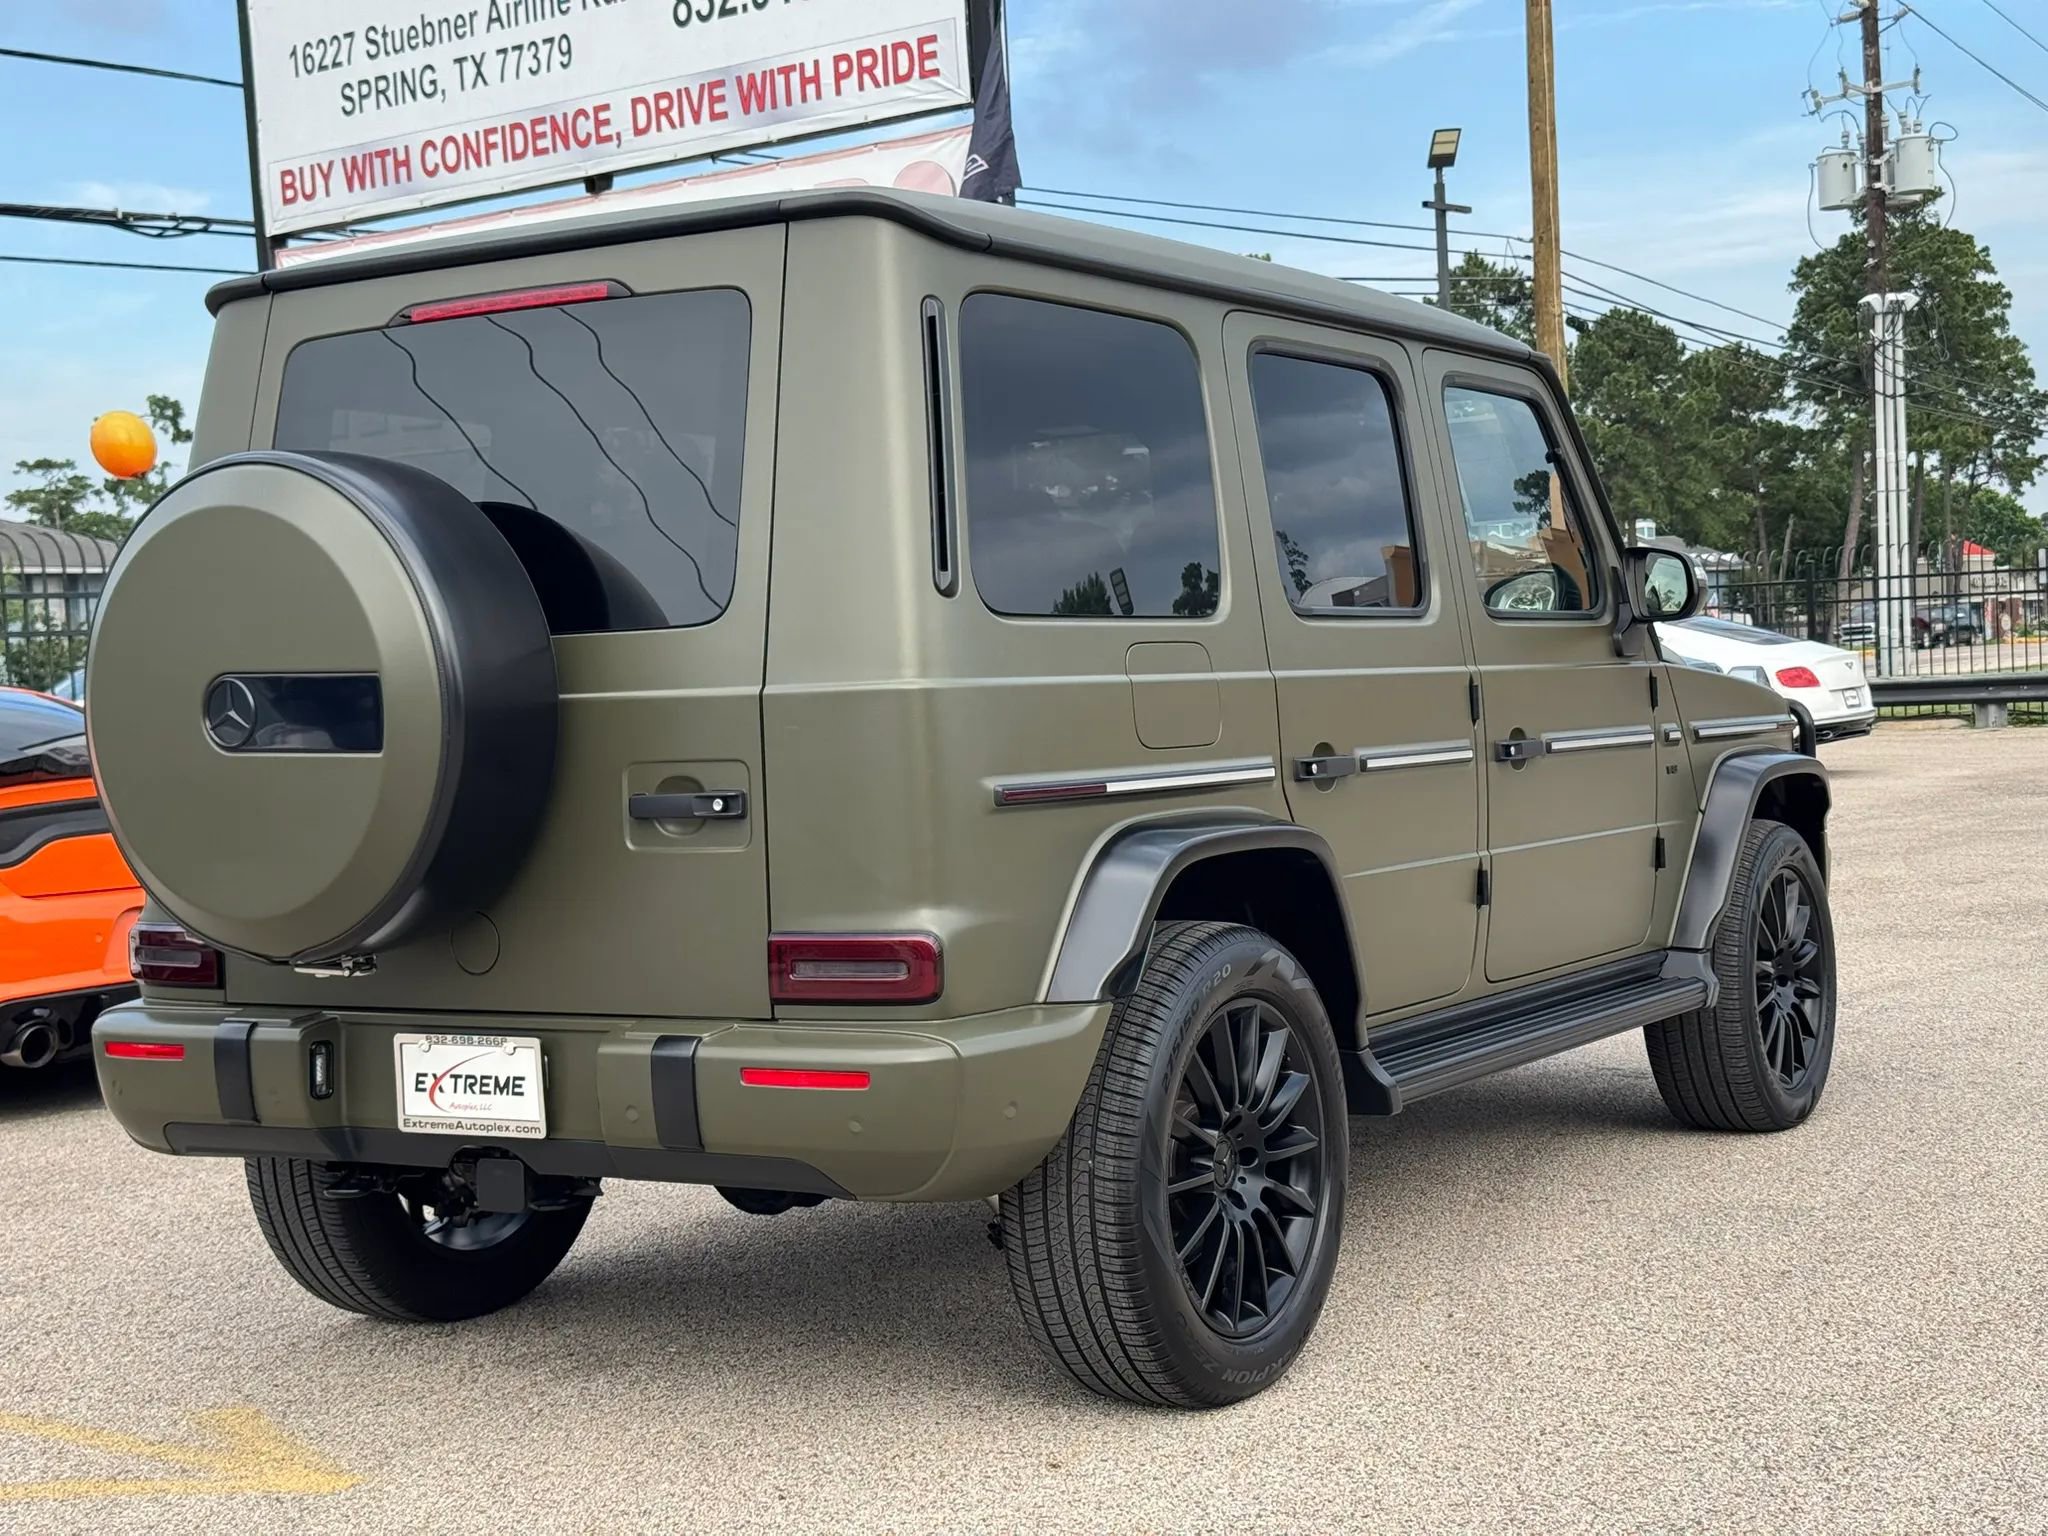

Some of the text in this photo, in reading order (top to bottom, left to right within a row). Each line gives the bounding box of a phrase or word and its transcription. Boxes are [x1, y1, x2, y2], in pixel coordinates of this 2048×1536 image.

[289, 0, 571, 78] 16227 Stuebner Airline
[340, 33, 572, 117] SPRING, TX 77379
[280, 34, 941, 206] BUY WITH CONFIDENCE, DRIVE WITH PRIDE
[414, 1072, 525, 1096] EXTREME
[403, 1118, 542, 1134] ExtremeAutoplex.com
